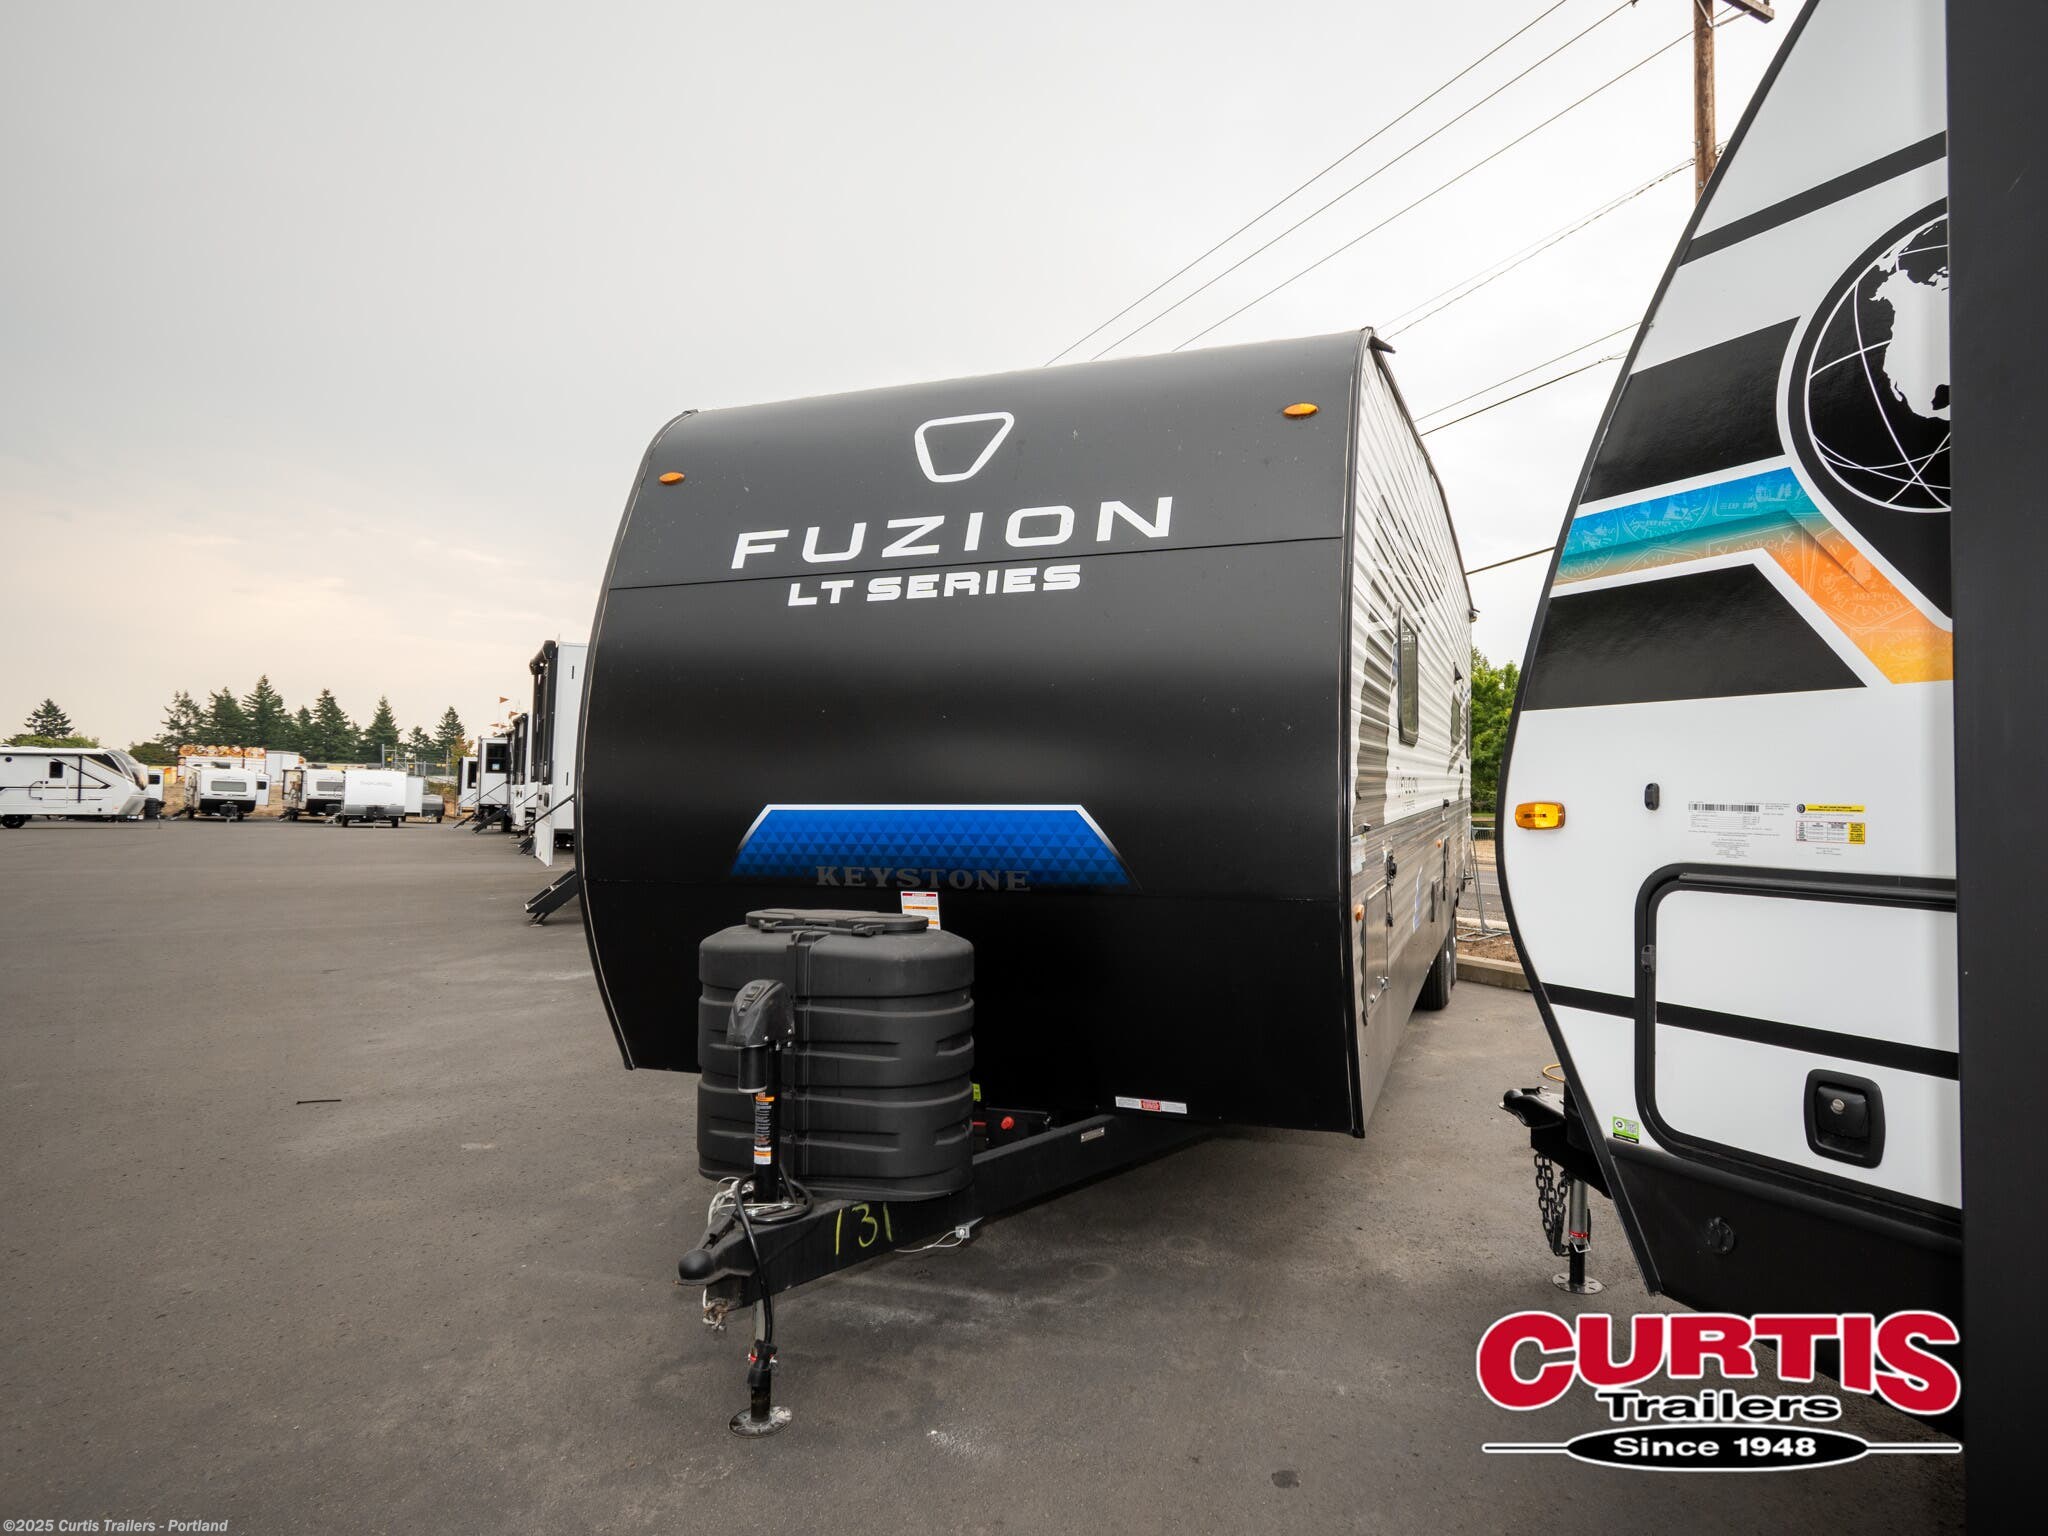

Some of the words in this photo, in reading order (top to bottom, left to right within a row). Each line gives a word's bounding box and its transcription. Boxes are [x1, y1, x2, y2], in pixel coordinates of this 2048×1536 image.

[731, 496, 1173, 569] FUZION
[788, 580, 854, 606] LT
[866, 564, 1081, 602] SERIES
[815, 866, 1031, 891] KEYSTONE
[835, 1202, 893, 1255] 131
